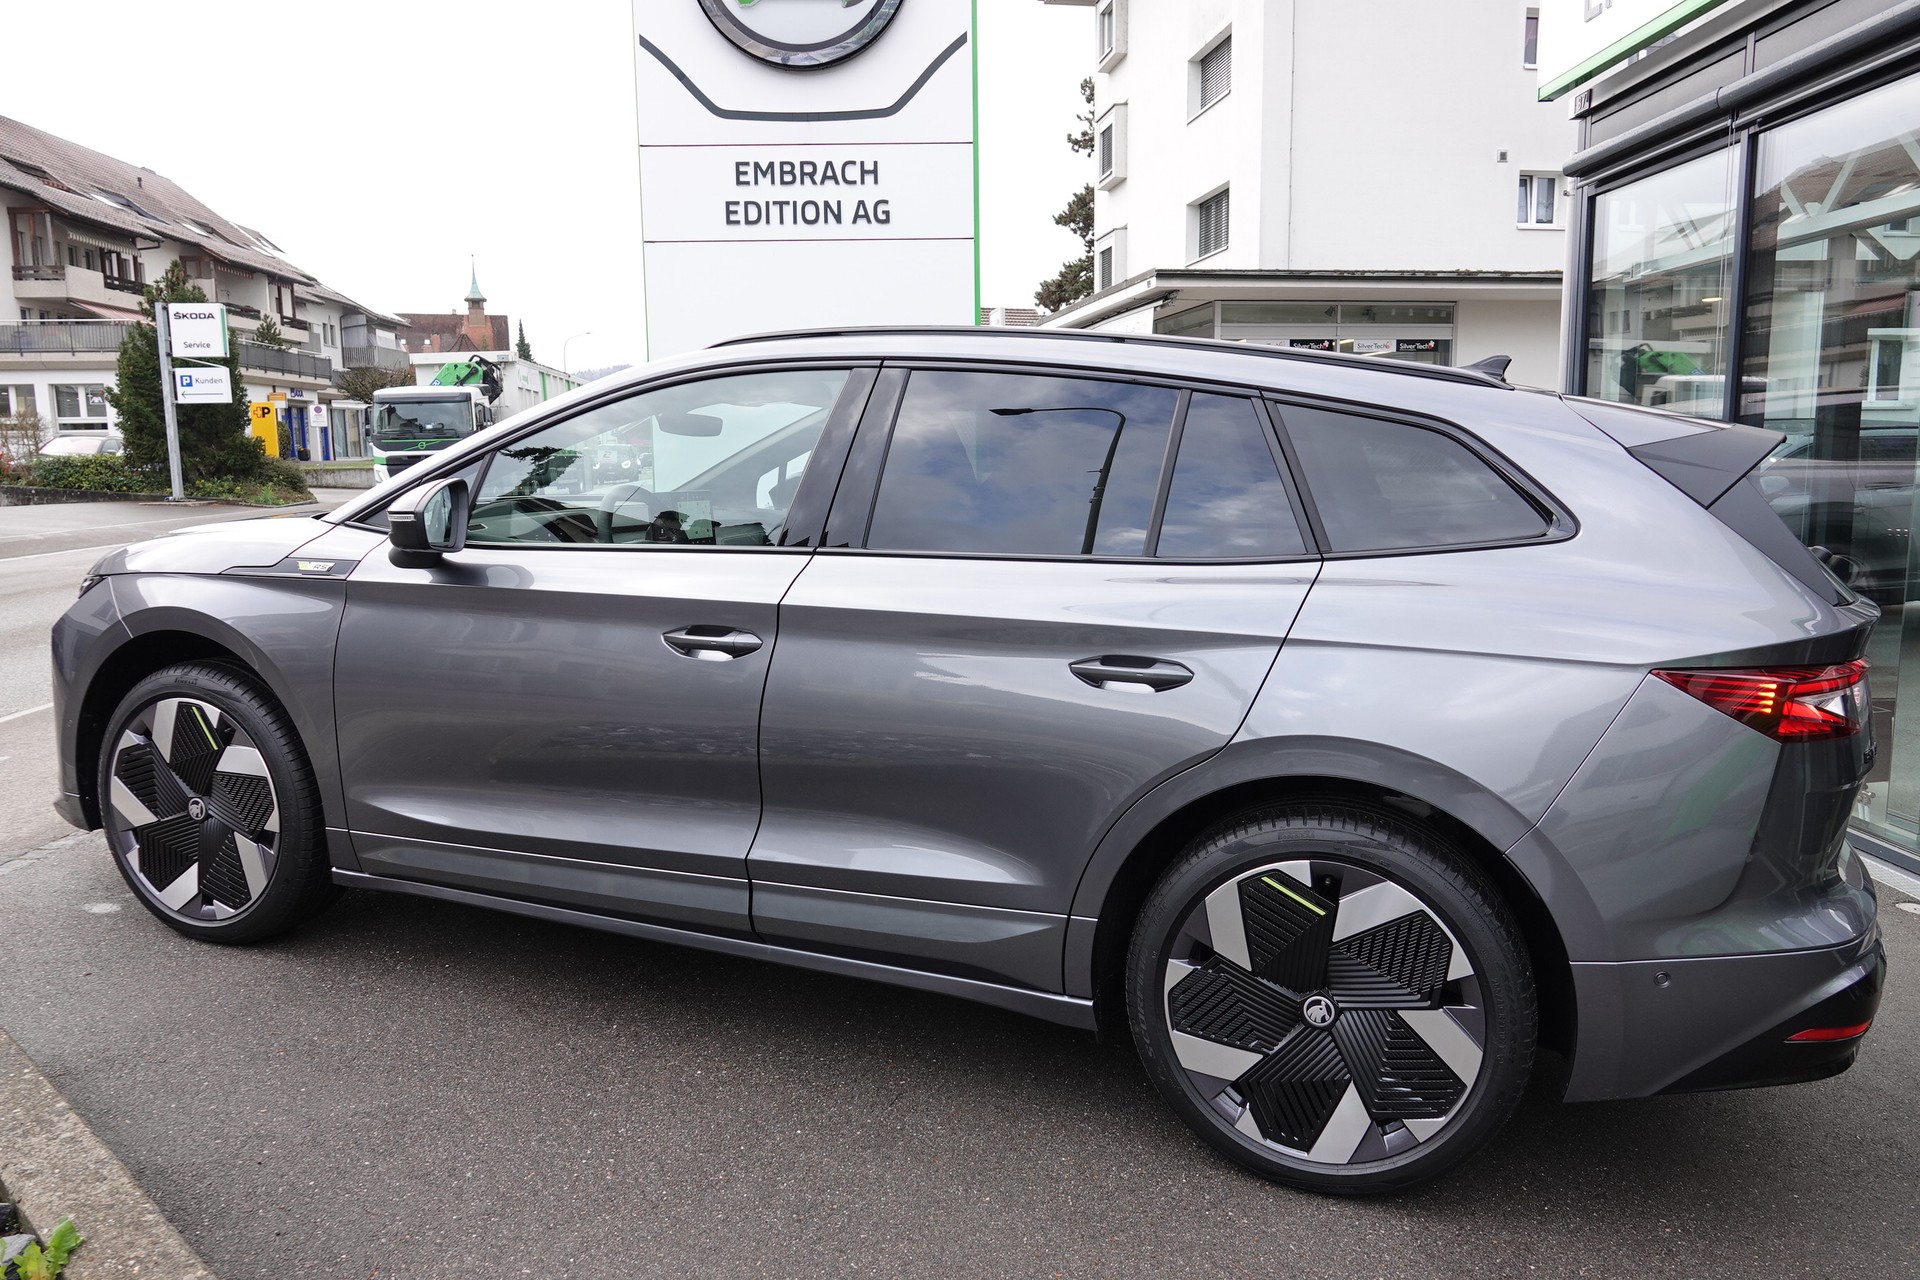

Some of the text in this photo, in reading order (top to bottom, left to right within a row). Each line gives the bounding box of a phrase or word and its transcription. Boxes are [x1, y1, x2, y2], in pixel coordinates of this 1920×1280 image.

[735, 160, 878, 185] EMBRACH
[725, 199, 891, 225] EDITION AG
[173, 311, 215, 319] ŠKODA
[183, 341, 211, 349] Service
